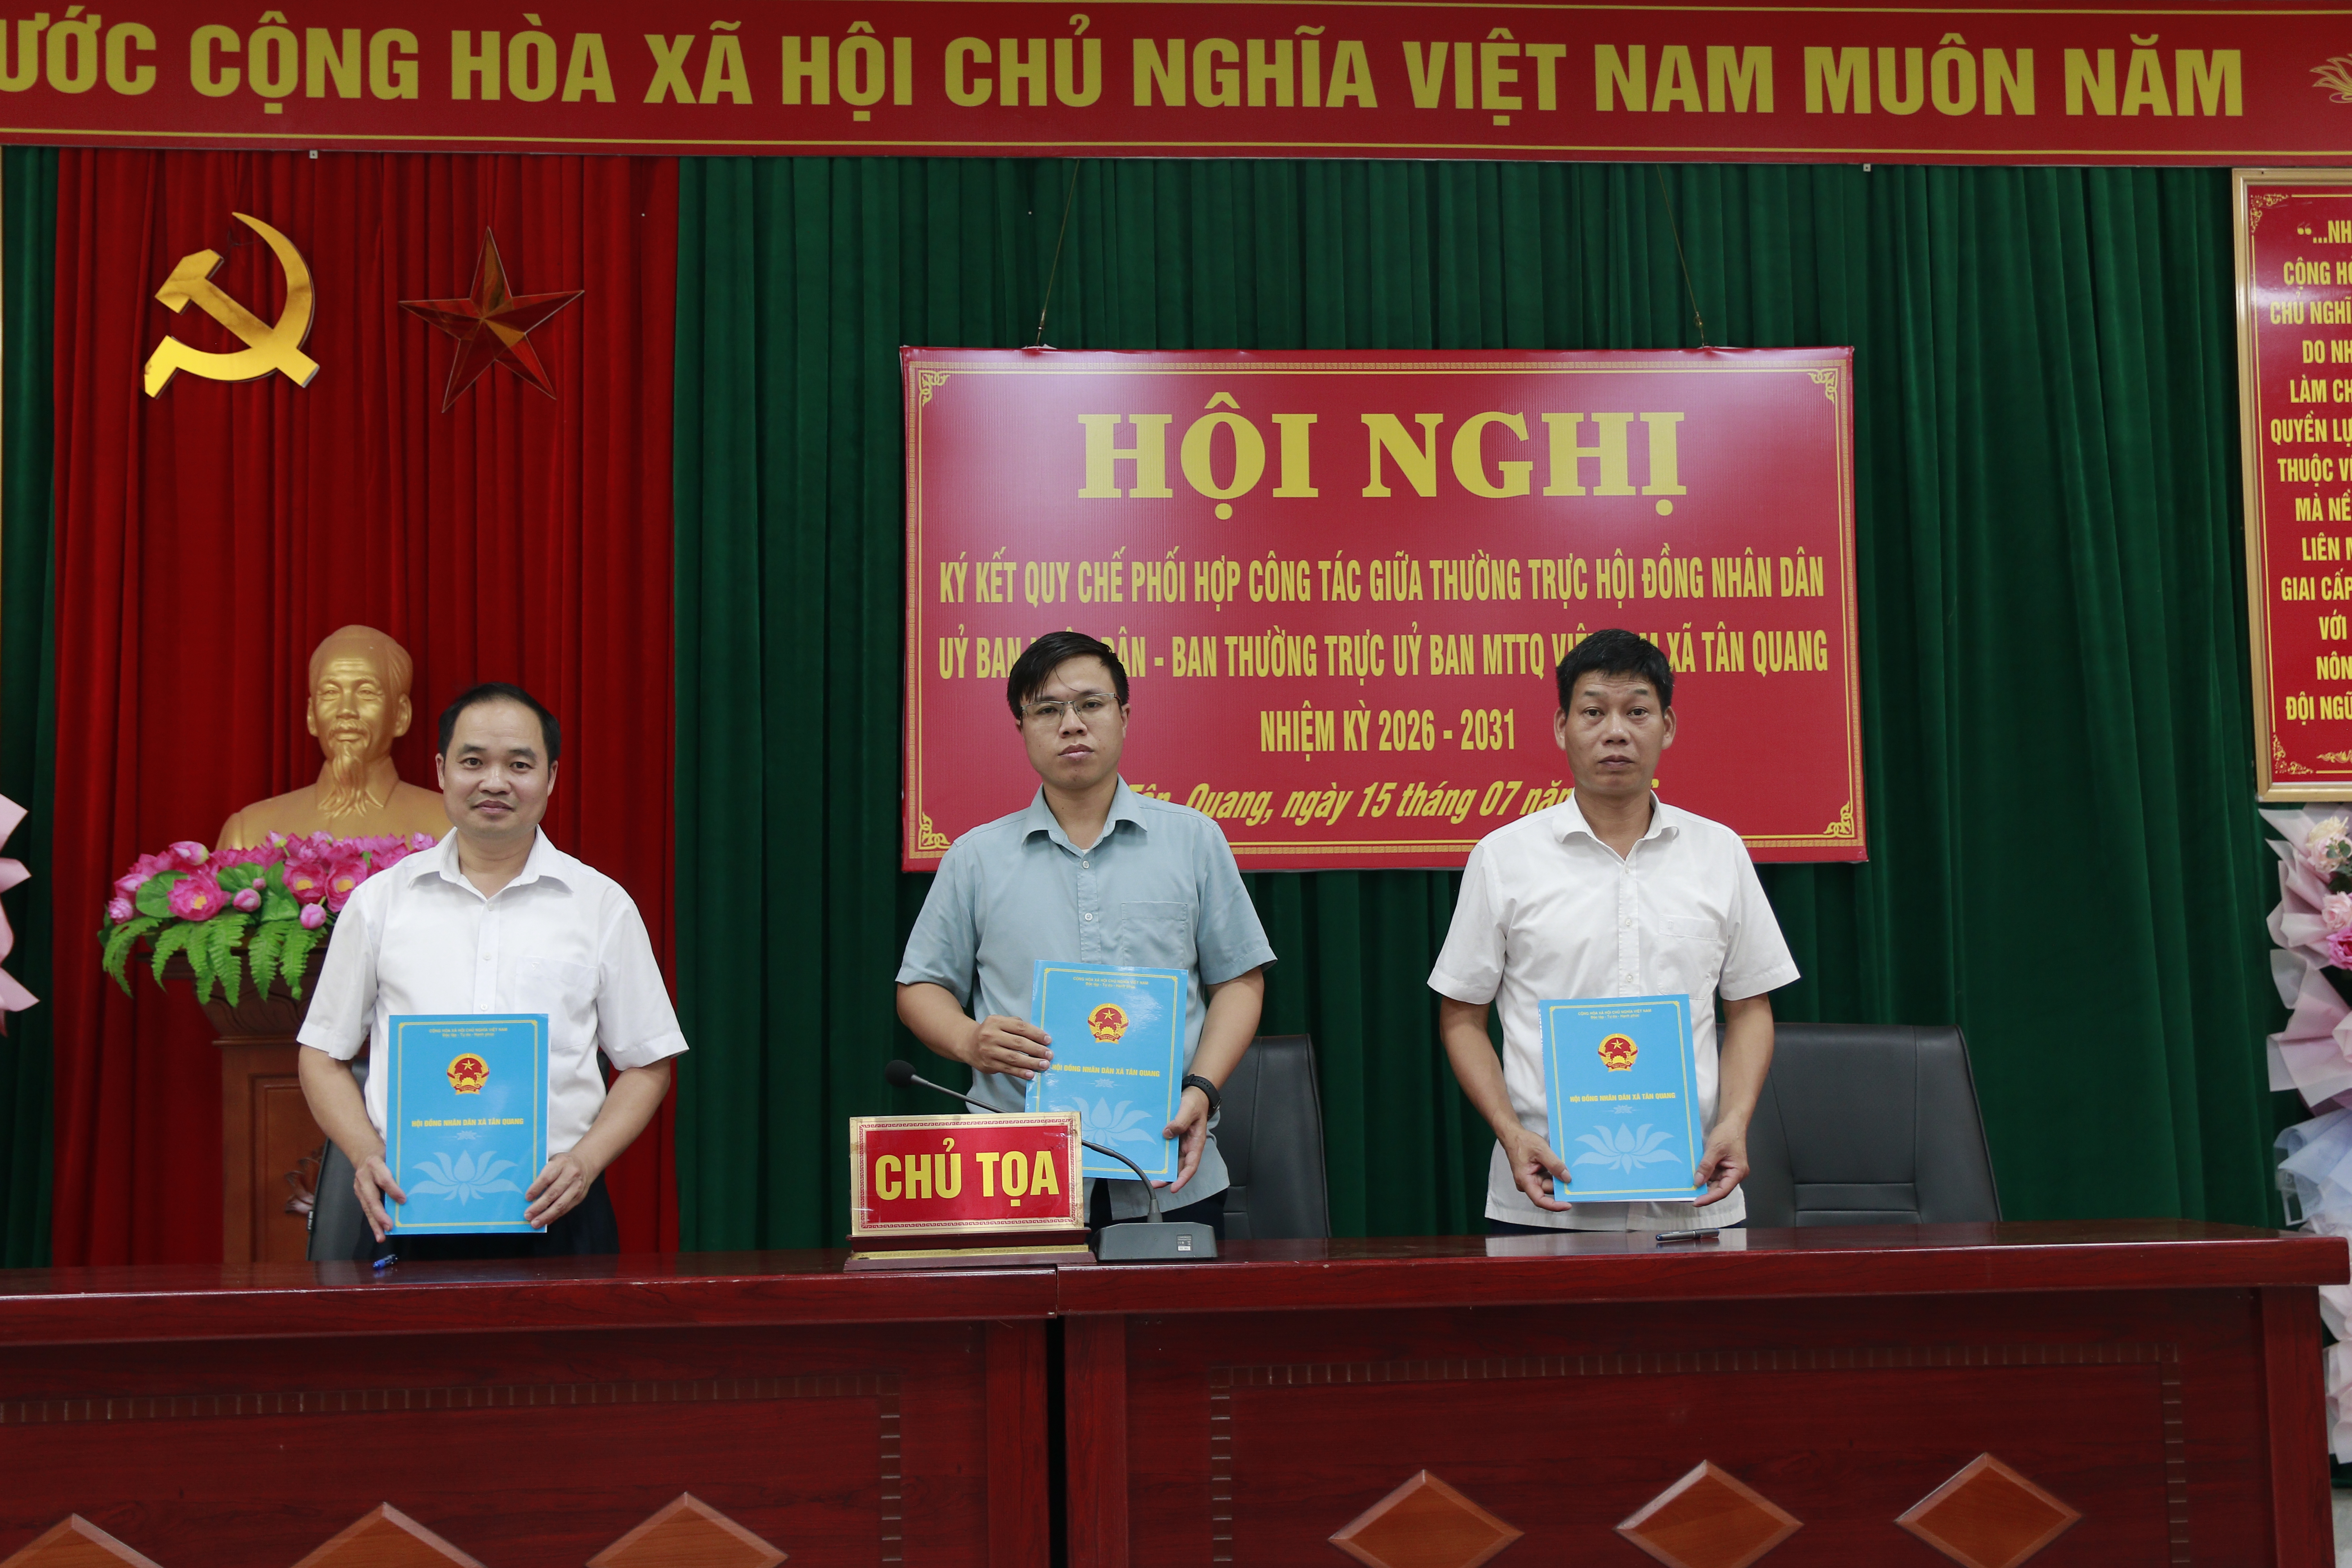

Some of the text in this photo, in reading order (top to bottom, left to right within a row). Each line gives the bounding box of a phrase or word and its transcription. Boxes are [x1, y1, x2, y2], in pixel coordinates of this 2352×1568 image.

[0, 5, 2243, 126] ƯỚC CỘNG HÒA XÃ HỘI CHỦ NGHĨA VIỆT NAM MUÔN NĂM
[2283, 256, 2331, 290] CỘNG
[2270, 290, 2352, 325] CHỦ NGHĨ
[2302, 339, 2327, 364] DO
[2290, 374, 2327, 403] LÀM
[2270, 410, 2328, 445] QUYỀN
[1078, 392, 1687, 520] HỘI NGHỊ
[2277, 453, 2334, 487] THUỘC
[2295, 492, 2324, 522] MÀ
[2301, 532, 2341, 561] LIÊN
[940, 543, 1825, 612] KÝ KẾT QUY CHẾ PHỐI HỢP CÔNG TÁC GIỮA THƯỜNG TRỰC HỘI ĐỒNG NHÂN DÂN
[2281, 576, 2316, 601] GIAI
[2318, 608, 2348, 641] VỚI
[939, 624, 969, 680] UỶ
[976, 637, 1022, 679] BAN
[1154, 657, 1164, 667] -
[1172, 635, 1218, 677] BAN
[1224, 625, 1318, 677] THƯỜNG
[1323, 629, 1385, 686] TRỰC
[1393, 621, 1423, 677] UỶ
[1429, 634, 1475, 676] BAN
[1482, 633, 1545, 679] MTTQ
[1666, 620, 1829, 677] XÃ TÂN QUANG
[2285, 689, 2315, 726] ĐỘI
[1260, 699, 1515, 762] NHIỆM KỲ 2026 - 2031
[1185, 782, 1274, 827] Quang,
[1281, 781, 1354, 826] ngày
[1357, 781, 1398, 818] 15
[1396, 780, 1478, 824] tháng
[1479, 780, 1523, 816] 07
[1052, 1063, 1062, 1072] HỘI
[1064, 1063, 1081, 1072] ĐỒNG
[1570, 1095, 1580, 1103] HỘI
[412, 1119, 423, 1128] HỘI
[424, 1118, 442, 1127] ĐỒNG
[875, 1137, 1060, 1207] CHỦ TỌA
